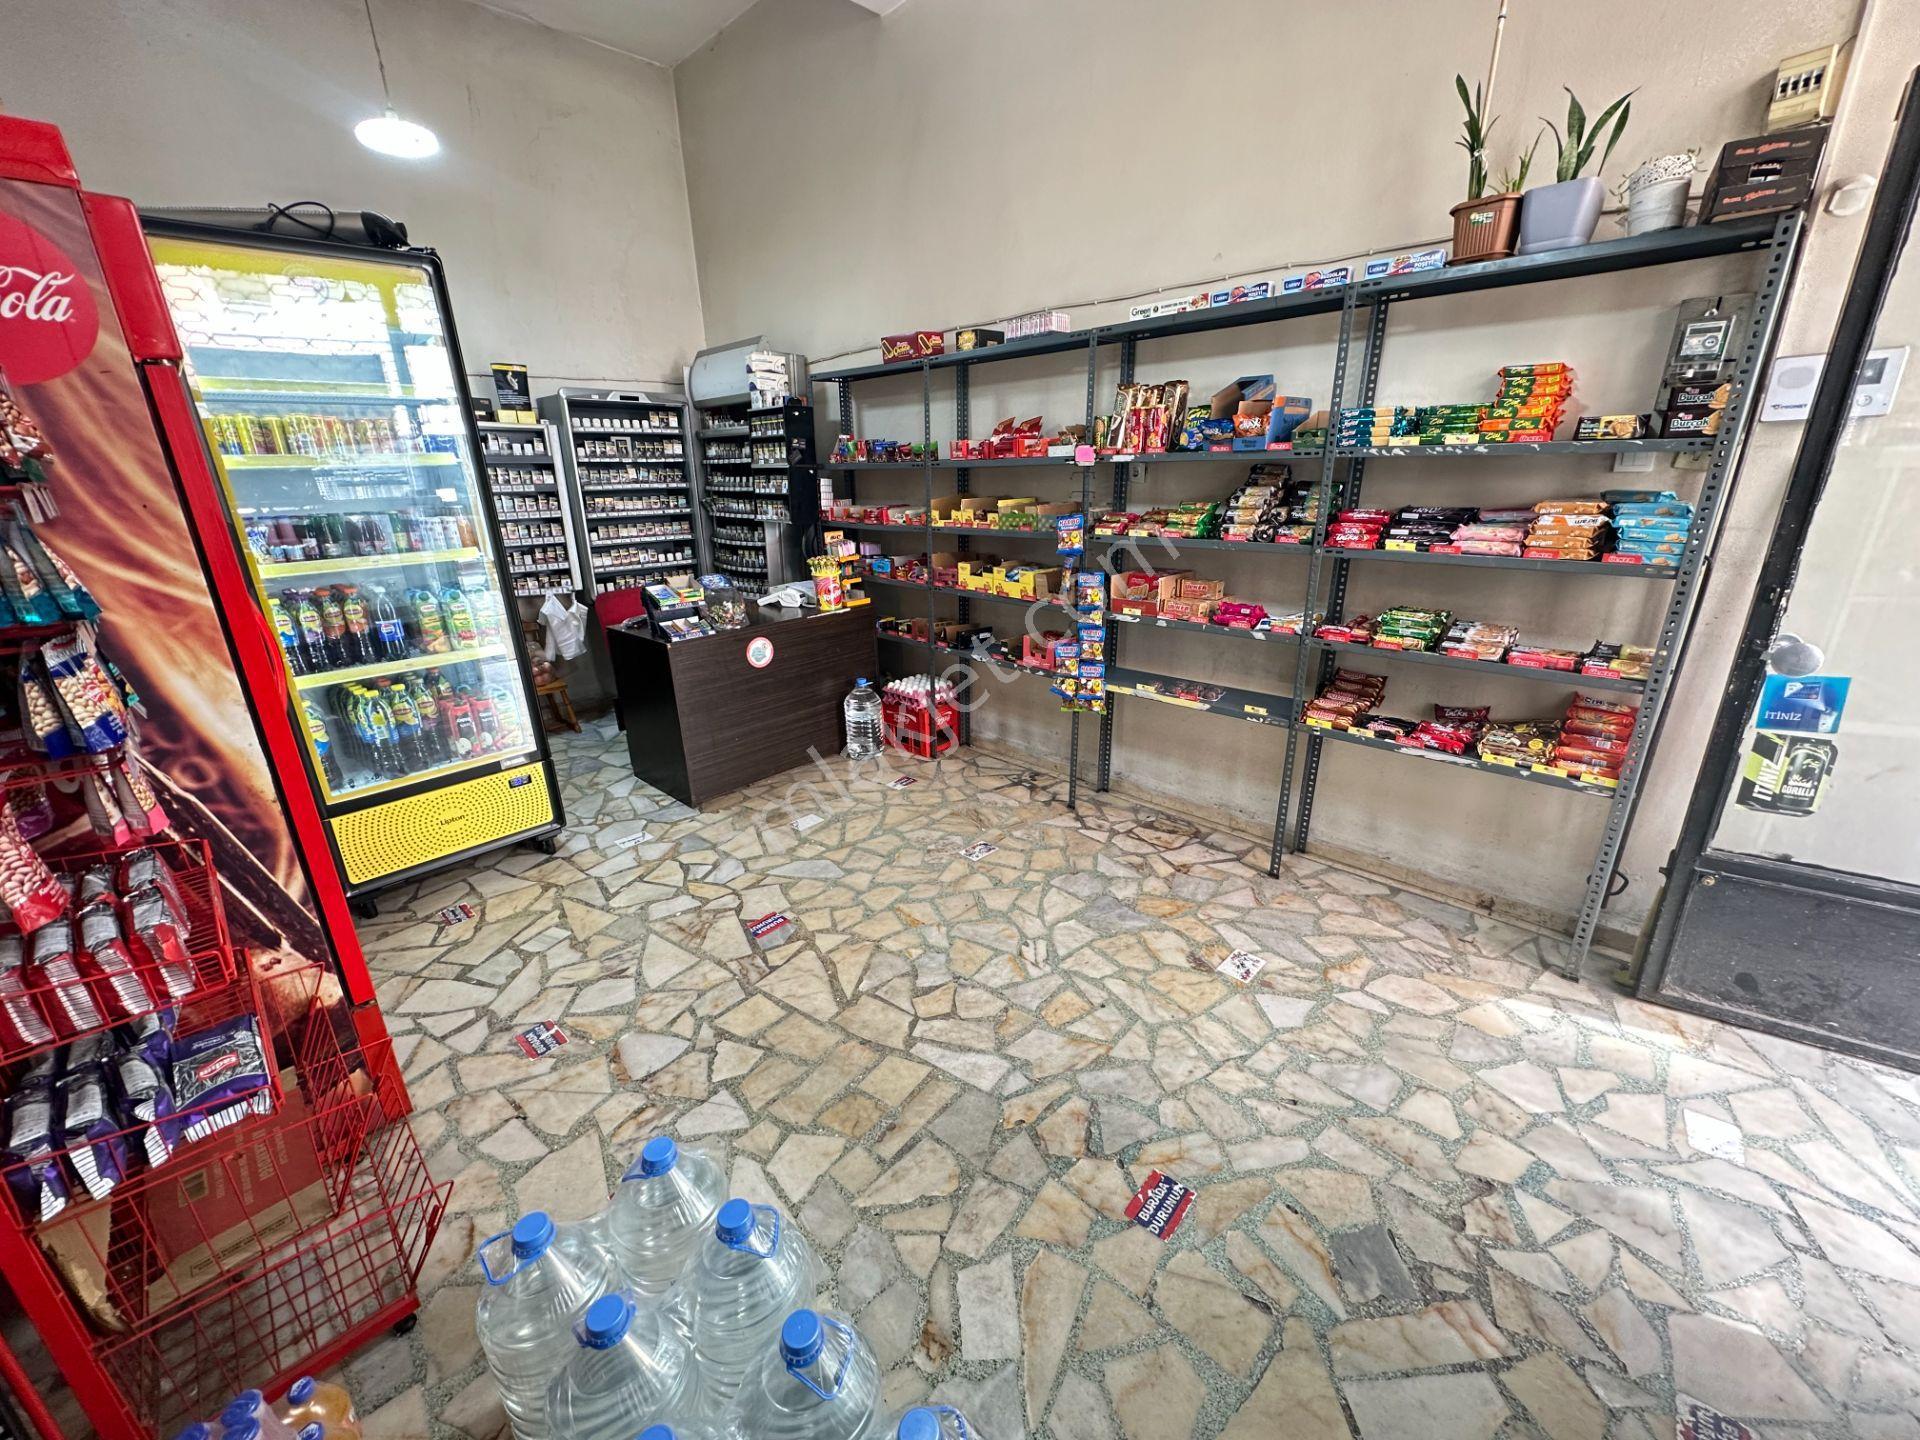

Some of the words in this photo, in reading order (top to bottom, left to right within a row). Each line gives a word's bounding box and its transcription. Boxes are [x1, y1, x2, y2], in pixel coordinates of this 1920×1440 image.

[0, 265, 75, 323] ola
[1678, 391, 1715, 403] Burçak
[1671, 418, 1709, 429] Burçak
[440, 814, 466, 826] Lipton
[1138, 1182, 1170, 1222] BURADA
[1149, 1184, 1184, 1234] DURUNUZ
